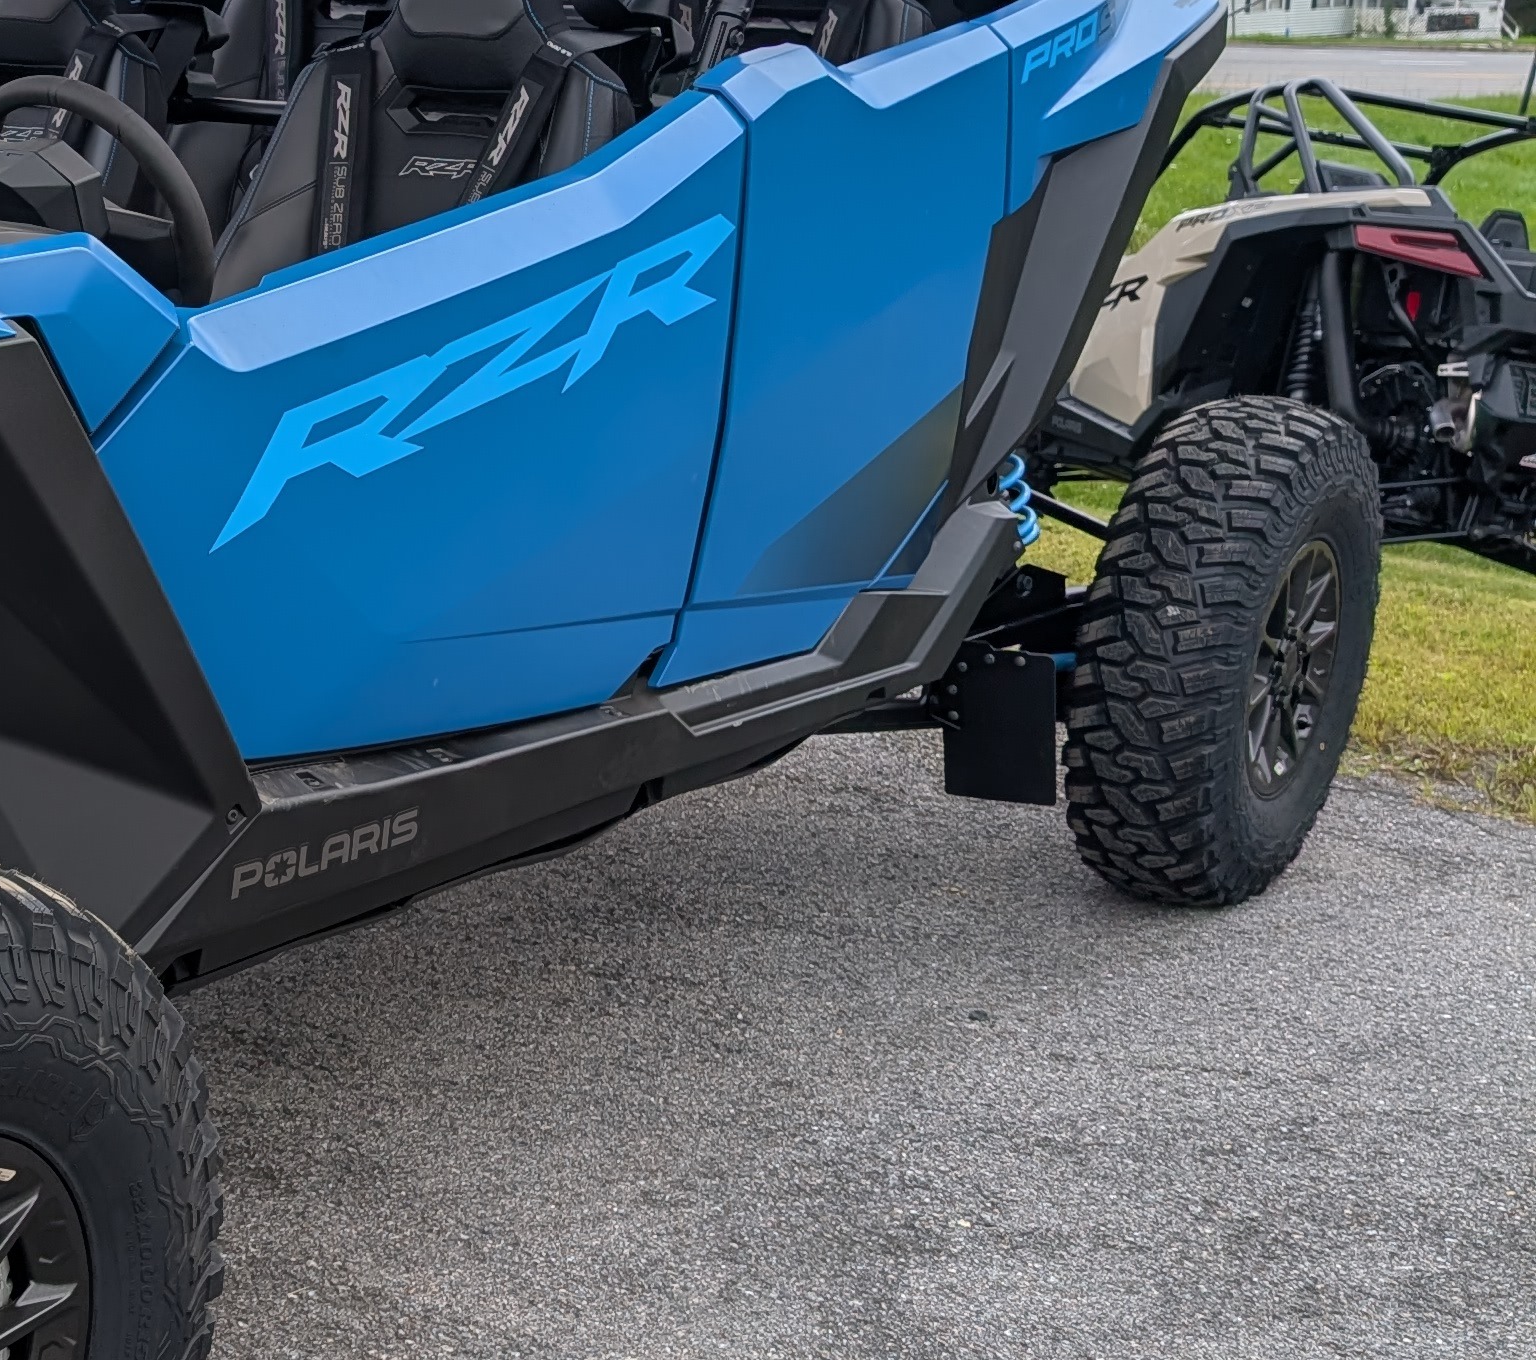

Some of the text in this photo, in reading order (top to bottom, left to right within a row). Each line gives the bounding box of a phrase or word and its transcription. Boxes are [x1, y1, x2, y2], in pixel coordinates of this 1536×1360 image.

[1021, 11, 1098, 84] PRO
[333, 80, 352, 160] RZR
[487, 84, 530, 167] RZR
[335, 166, 348, 199] SUB
[331, 202, 344, 246] ZERO
[209, 213, 736, 554] RZR
[230, 807, 419, 900] POLARIS
